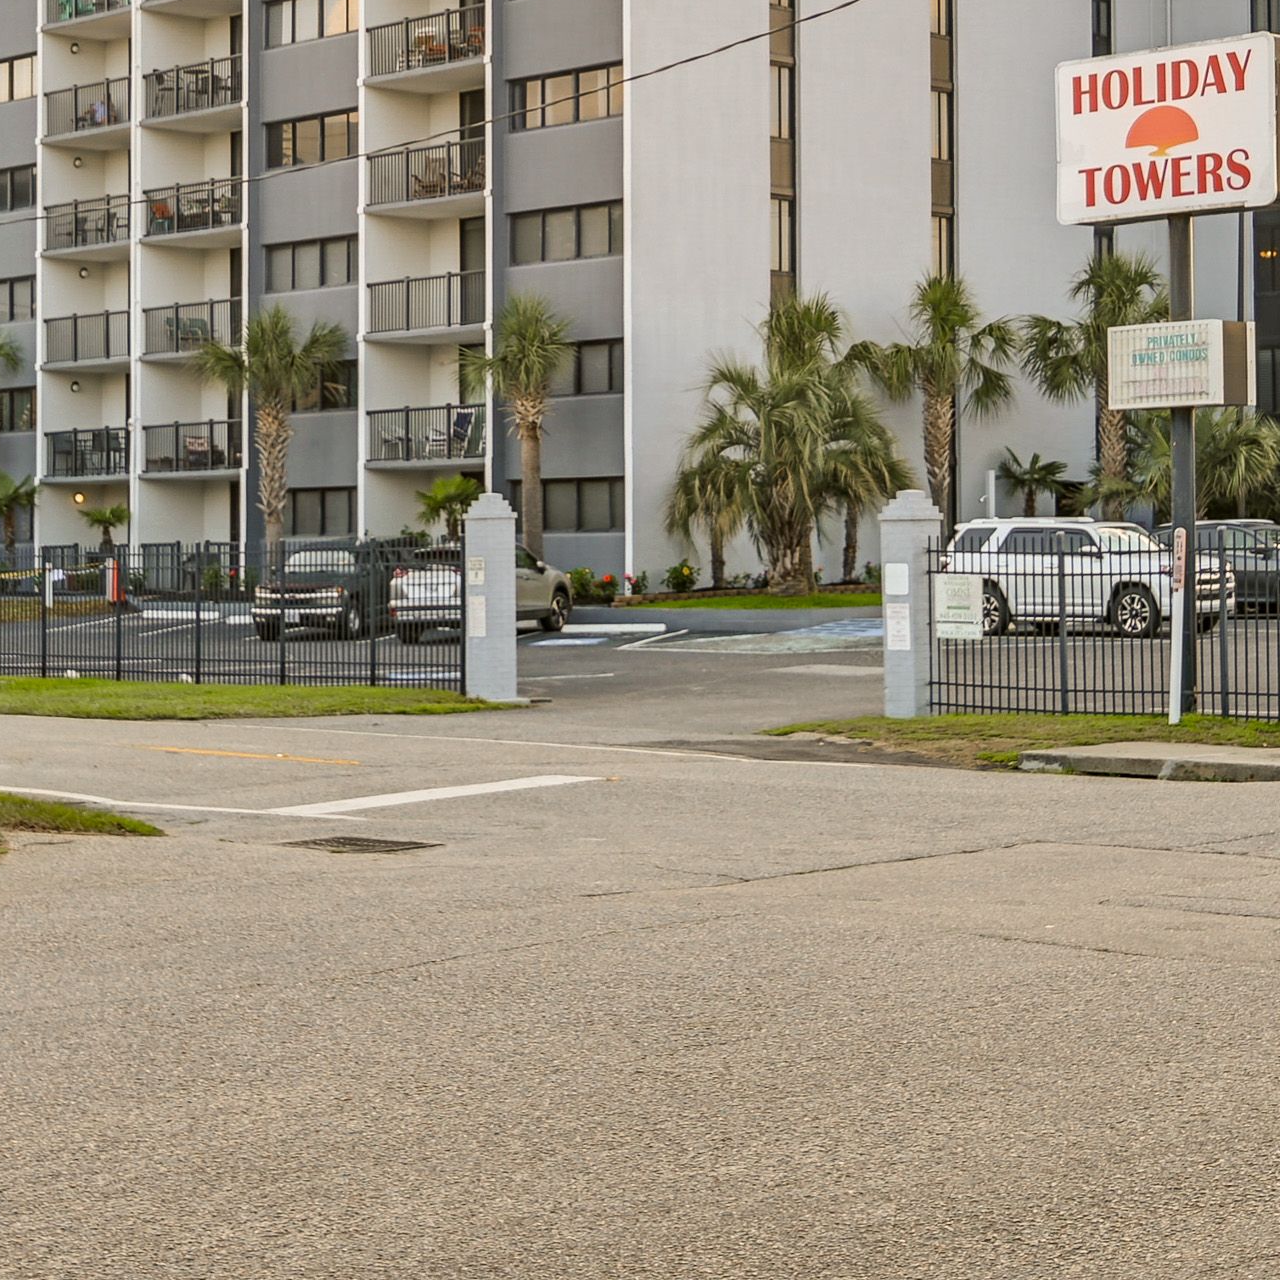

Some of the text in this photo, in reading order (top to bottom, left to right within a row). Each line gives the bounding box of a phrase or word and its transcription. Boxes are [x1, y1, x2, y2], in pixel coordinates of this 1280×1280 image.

[1072, 49, 1252, 115] HOLIDAY
[1078, 148, 1251, 208] TOWERS
[1132, 348, 1208, 365] OWNED CONDOS
[1147, 333, 1196, 347] PRIVATELY
